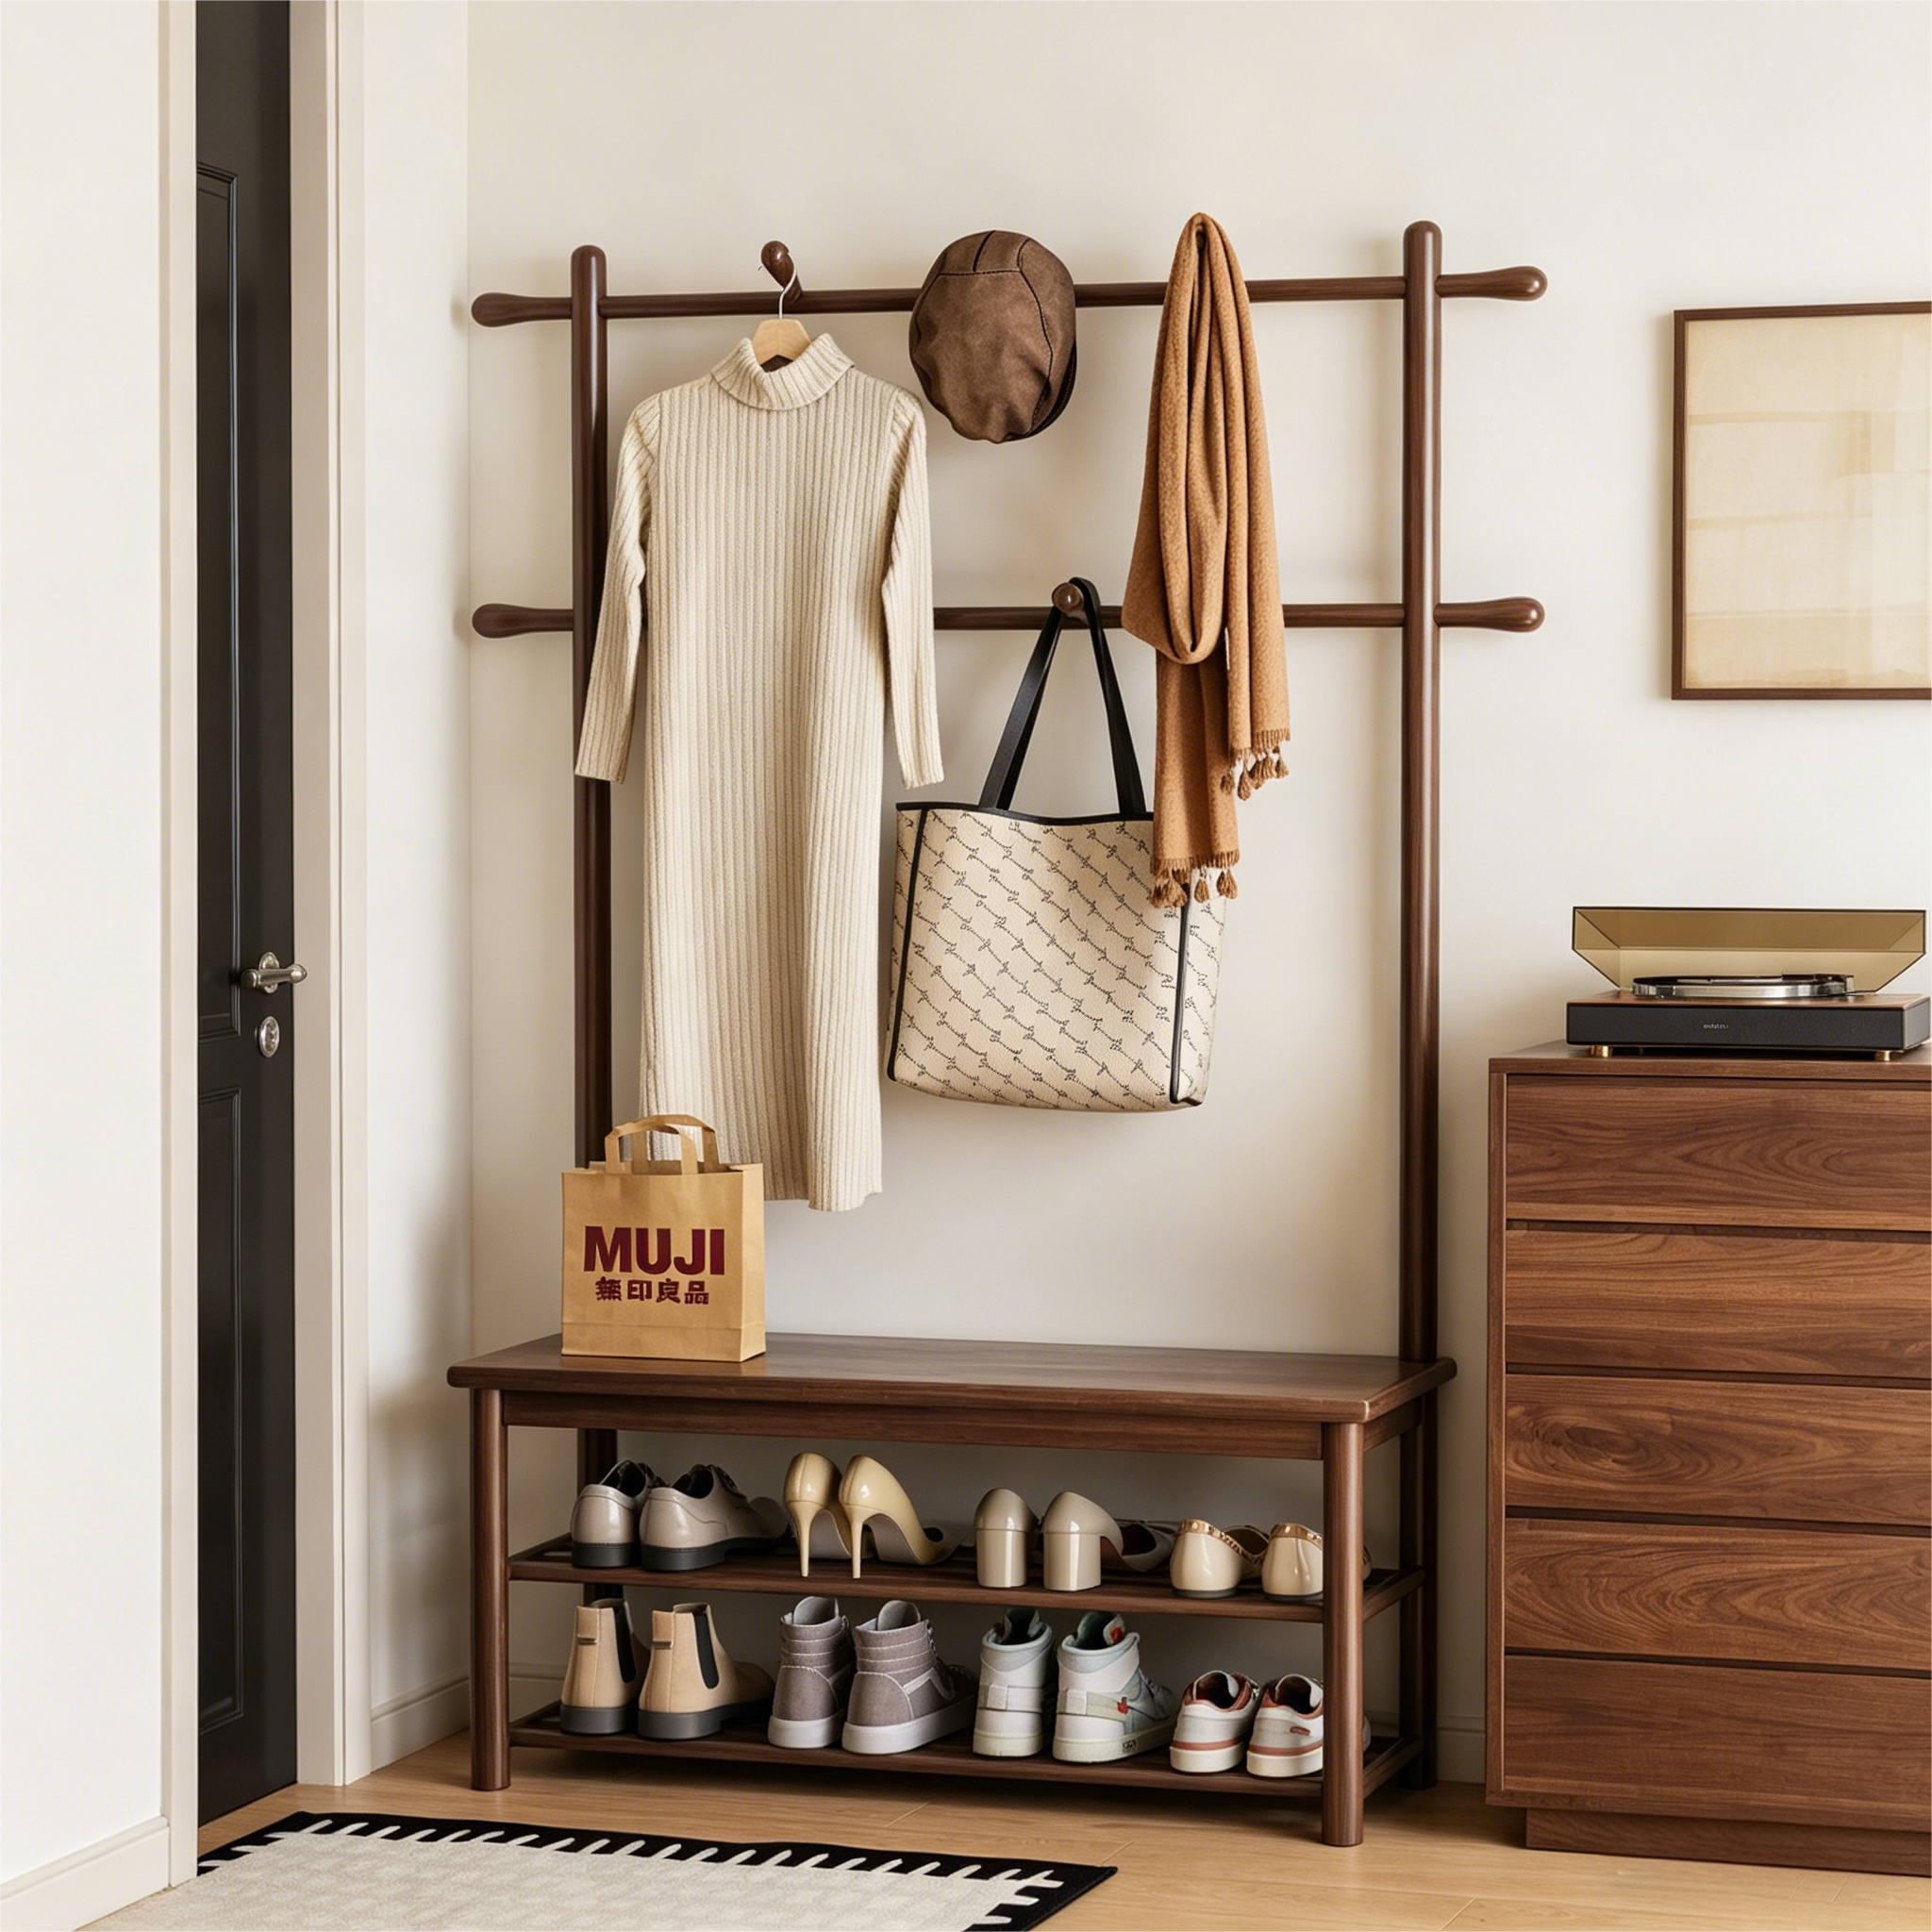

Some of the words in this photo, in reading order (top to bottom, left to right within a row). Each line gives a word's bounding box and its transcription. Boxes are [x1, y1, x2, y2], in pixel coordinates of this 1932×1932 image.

[584, 1225, 724, 1275] MUJI
[595, 1276, 709, 1305] 無印良品
